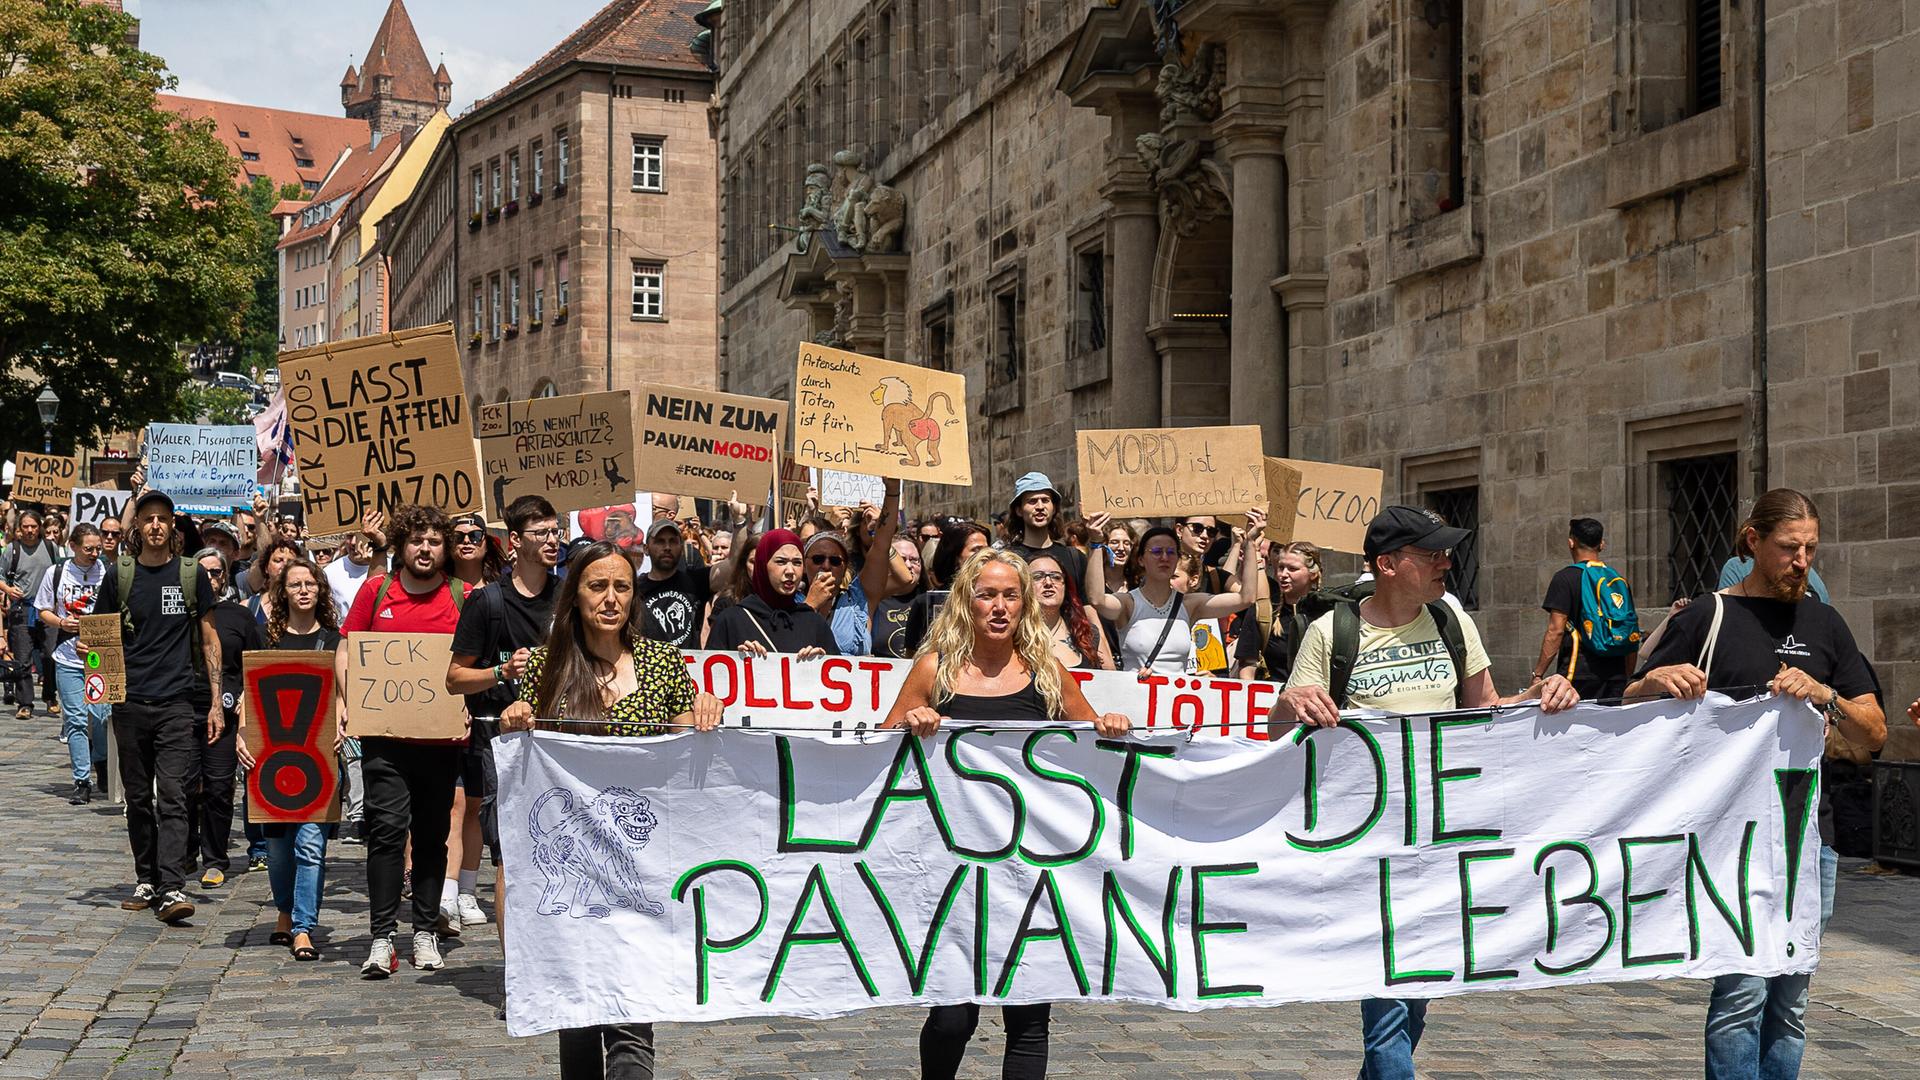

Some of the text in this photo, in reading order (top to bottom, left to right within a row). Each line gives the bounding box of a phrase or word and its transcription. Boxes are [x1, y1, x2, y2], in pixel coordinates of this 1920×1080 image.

[803, 353, 861, 376] Artenschutz
[321, 357, 427, 410] LASST
[801, 374, 831, 389] durch
[324, 394, 461, 448] DIE AFFEN
[482, 407, 502, 420] FCK
[512, 412, 609, 435] DAS NENNT IHR
[646, 393, 778, 434] NEIN ZUM
[800, 411, 816, 426] ist
[516, 425, 614, 452] ARTENSCHUTZ?
[643, 430, 773, 463] PAVIANMORD!
[801, 439, 860, 464] Arsch!
[22, 456, 75, 478] MORD
[364, 437, 416, 477] AUS
[486, 450, 593, 475] ICH NENNE ES
[1086, 433, 1217, 475] MORD ist
[37, 475, 54, 486] im
[151, 465, 170, 480] Was
[173, 468, 196, 479] wird
[300, 453, 330, 515] FCK
[545, 469, 598, 491] MORD!
[675, 464, 736, 481] #FCKZOOS
[15, 474, 72, 501] Tiergarten
[1102, 486, 1144, 509] kein
[1152, 464, 1263, 509] Artenschutz!
[359, 640, 428, 667] FCK
[359, 678, 436, 711] ZOOS
[774, 713, 1503, 867] LASST DIE
[671, 768, 1818, 1005] PAVIANE LEBEN!
